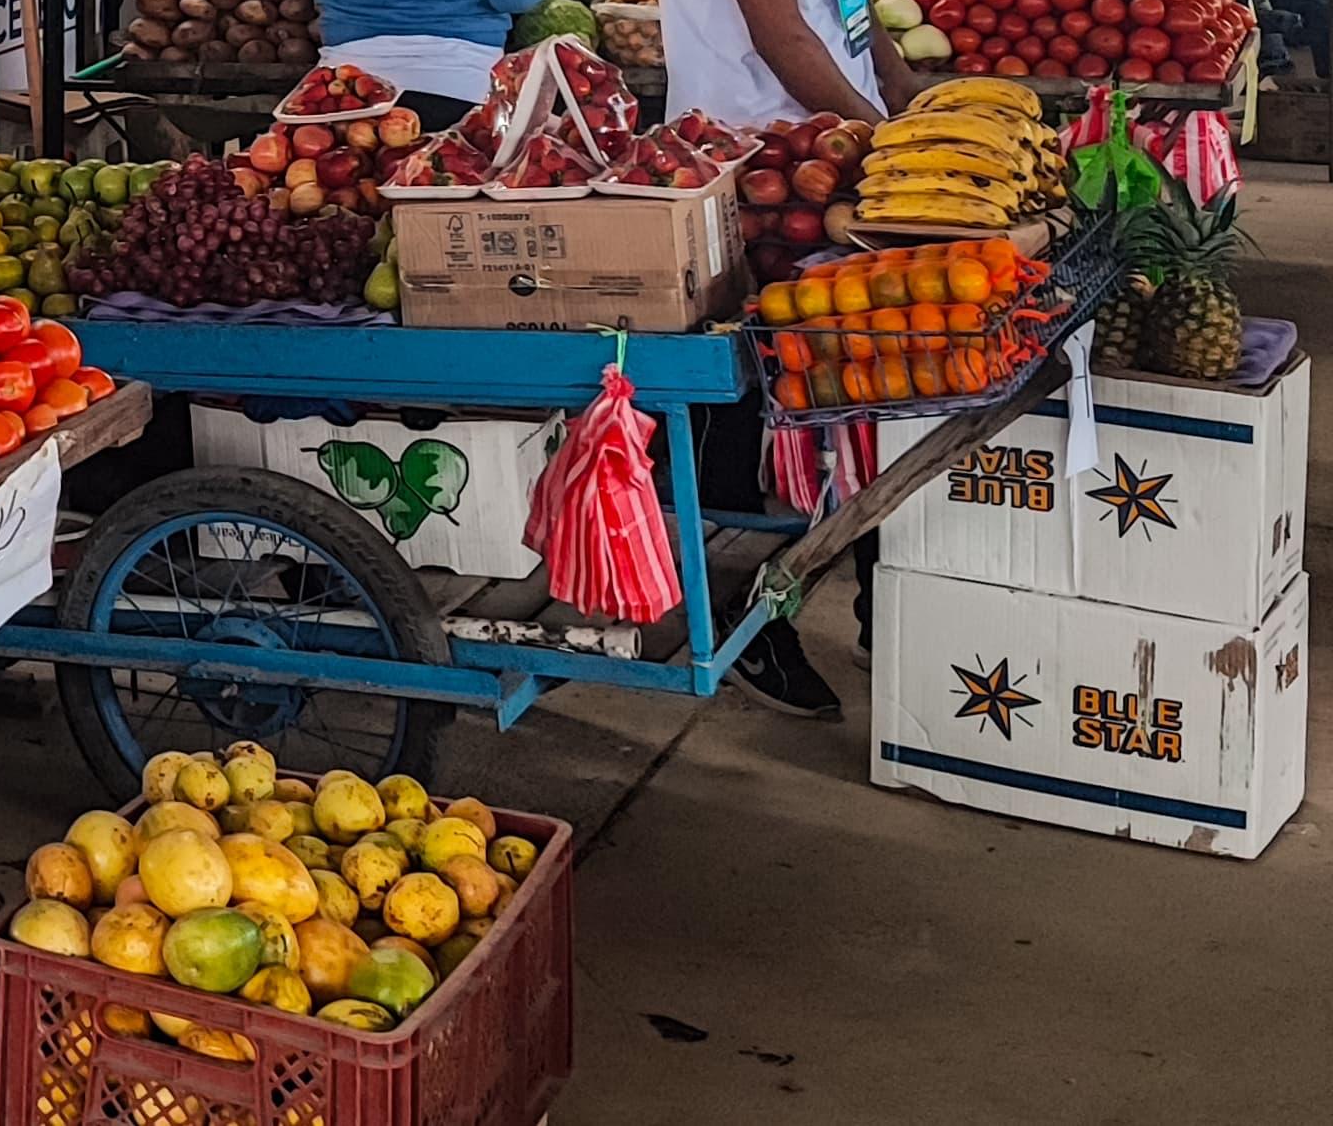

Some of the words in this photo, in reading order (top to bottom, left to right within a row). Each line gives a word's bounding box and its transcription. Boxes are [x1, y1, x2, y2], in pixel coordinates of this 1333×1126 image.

[949, 473, 1054, 512] BLUE
[1073, 685, 1182, 729] BLUE
[1073, 717, 1183, 763] STAR
